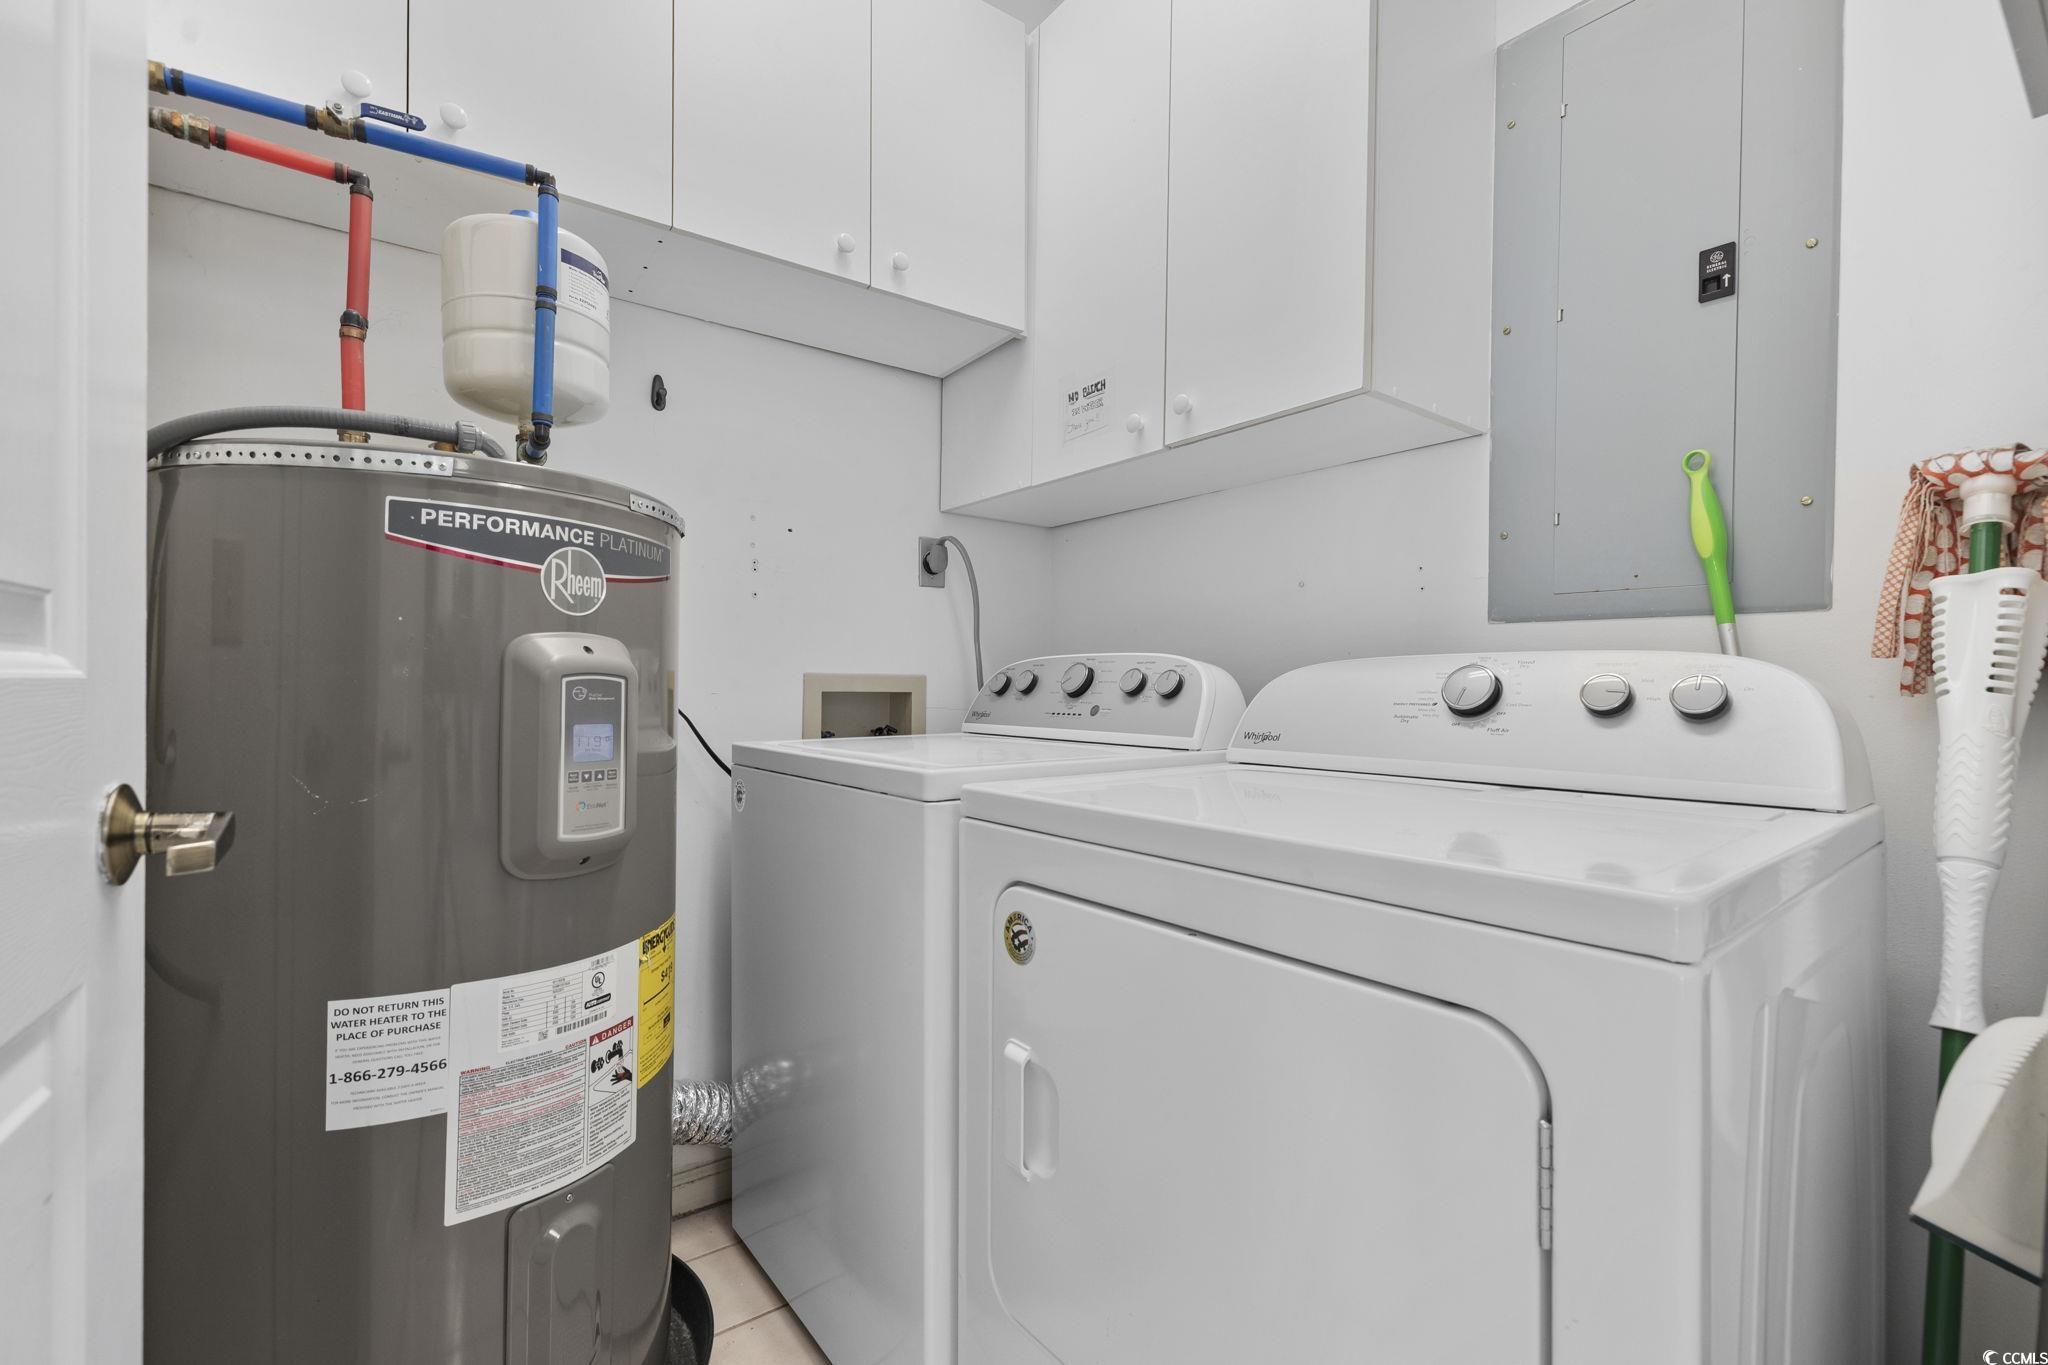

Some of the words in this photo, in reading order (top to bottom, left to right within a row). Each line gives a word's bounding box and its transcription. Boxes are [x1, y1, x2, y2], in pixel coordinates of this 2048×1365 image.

[420, 508, 595, 547] PERFORMANCE
[599, 532, 663, 563] PLATINUM
[550, 548, 602, 604] Rheem
[1243, 731, 1281, 744] Whirlpool
[333, 1008, 350, 1017] DO
[352, 1005, 375, 1015] NOT
[377, 1000, 419, 1014] RETURN
[420, 997, 445, 1007] THIS
[330, 1019, 366, 1030] WATER
[369, 1014, 408, 1026] HEATER
[411, 1012, 425, 1021] TO
[427, 1008, 447, 1018] THE
[601, 1019, 632, 1040] DANGER
[336, 1031, 367, 1041] PLACE
[370, 1029, 385, 1038] OF
[387, 1021, 441, 1036] PURCHASE
[329, 1058, 447, 1085] 1-866-279-4566
[460, 1065, 491, 1076] WARNING
